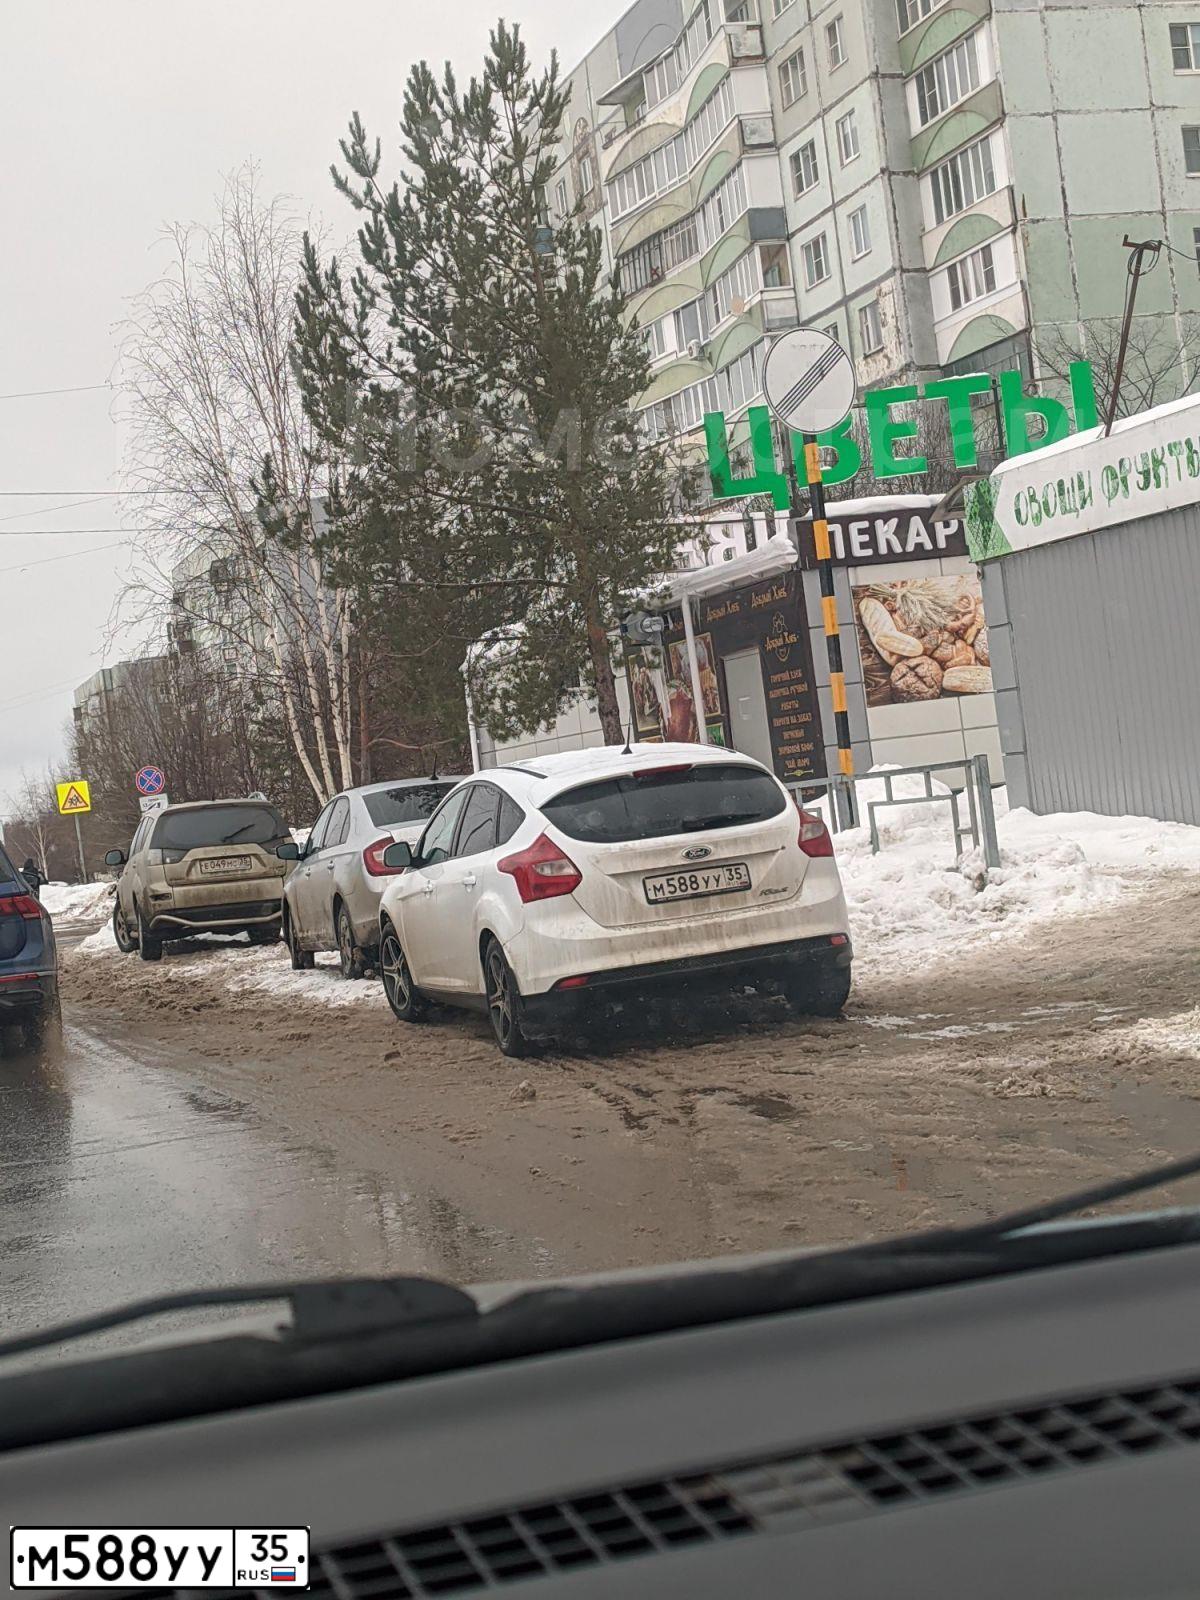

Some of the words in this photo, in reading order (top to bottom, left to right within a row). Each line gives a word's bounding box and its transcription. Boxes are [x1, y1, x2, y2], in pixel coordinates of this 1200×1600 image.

[703, 360, 1098, 510] ЦВЕТЫ
[1014, 470, 1093, 527] ОВОЩИ
[827, 514, 969, 560] ПЕКАР
[653, 874, 721, 897] М588УУ
[726, 867, 742, 881] 35
